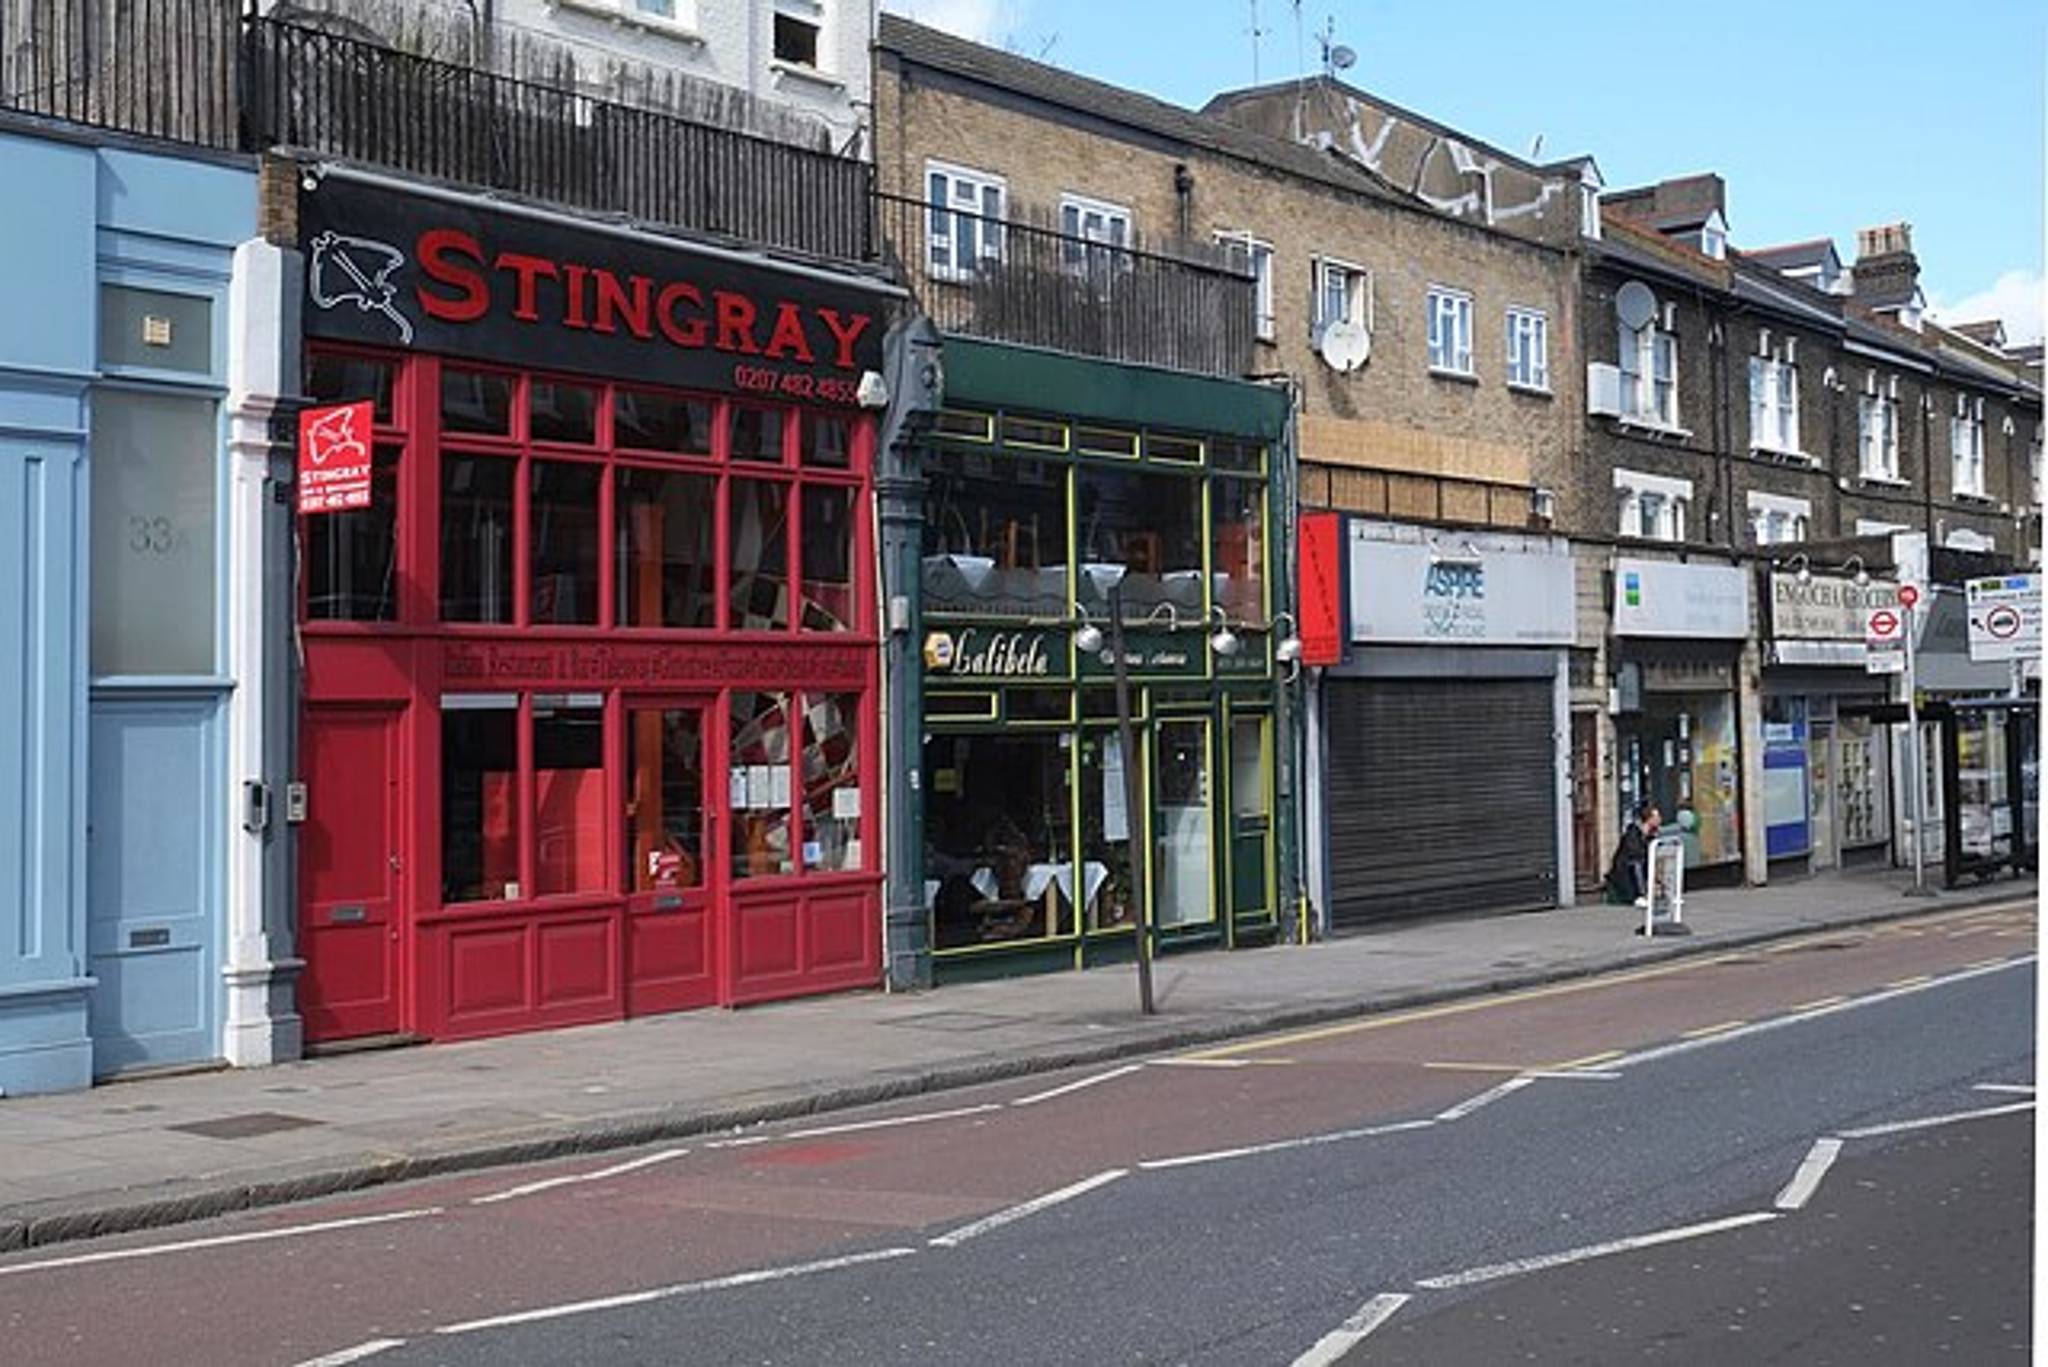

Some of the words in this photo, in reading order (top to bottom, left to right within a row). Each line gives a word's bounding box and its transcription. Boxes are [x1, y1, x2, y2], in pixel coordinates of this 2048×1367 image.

[414, 228, 870, 368] STINGRAY
[734, 365, 778, 391] 0207
[300, 465, 371, 485] STINGRAY
[943, 628, 1048, 676] Lalibela
